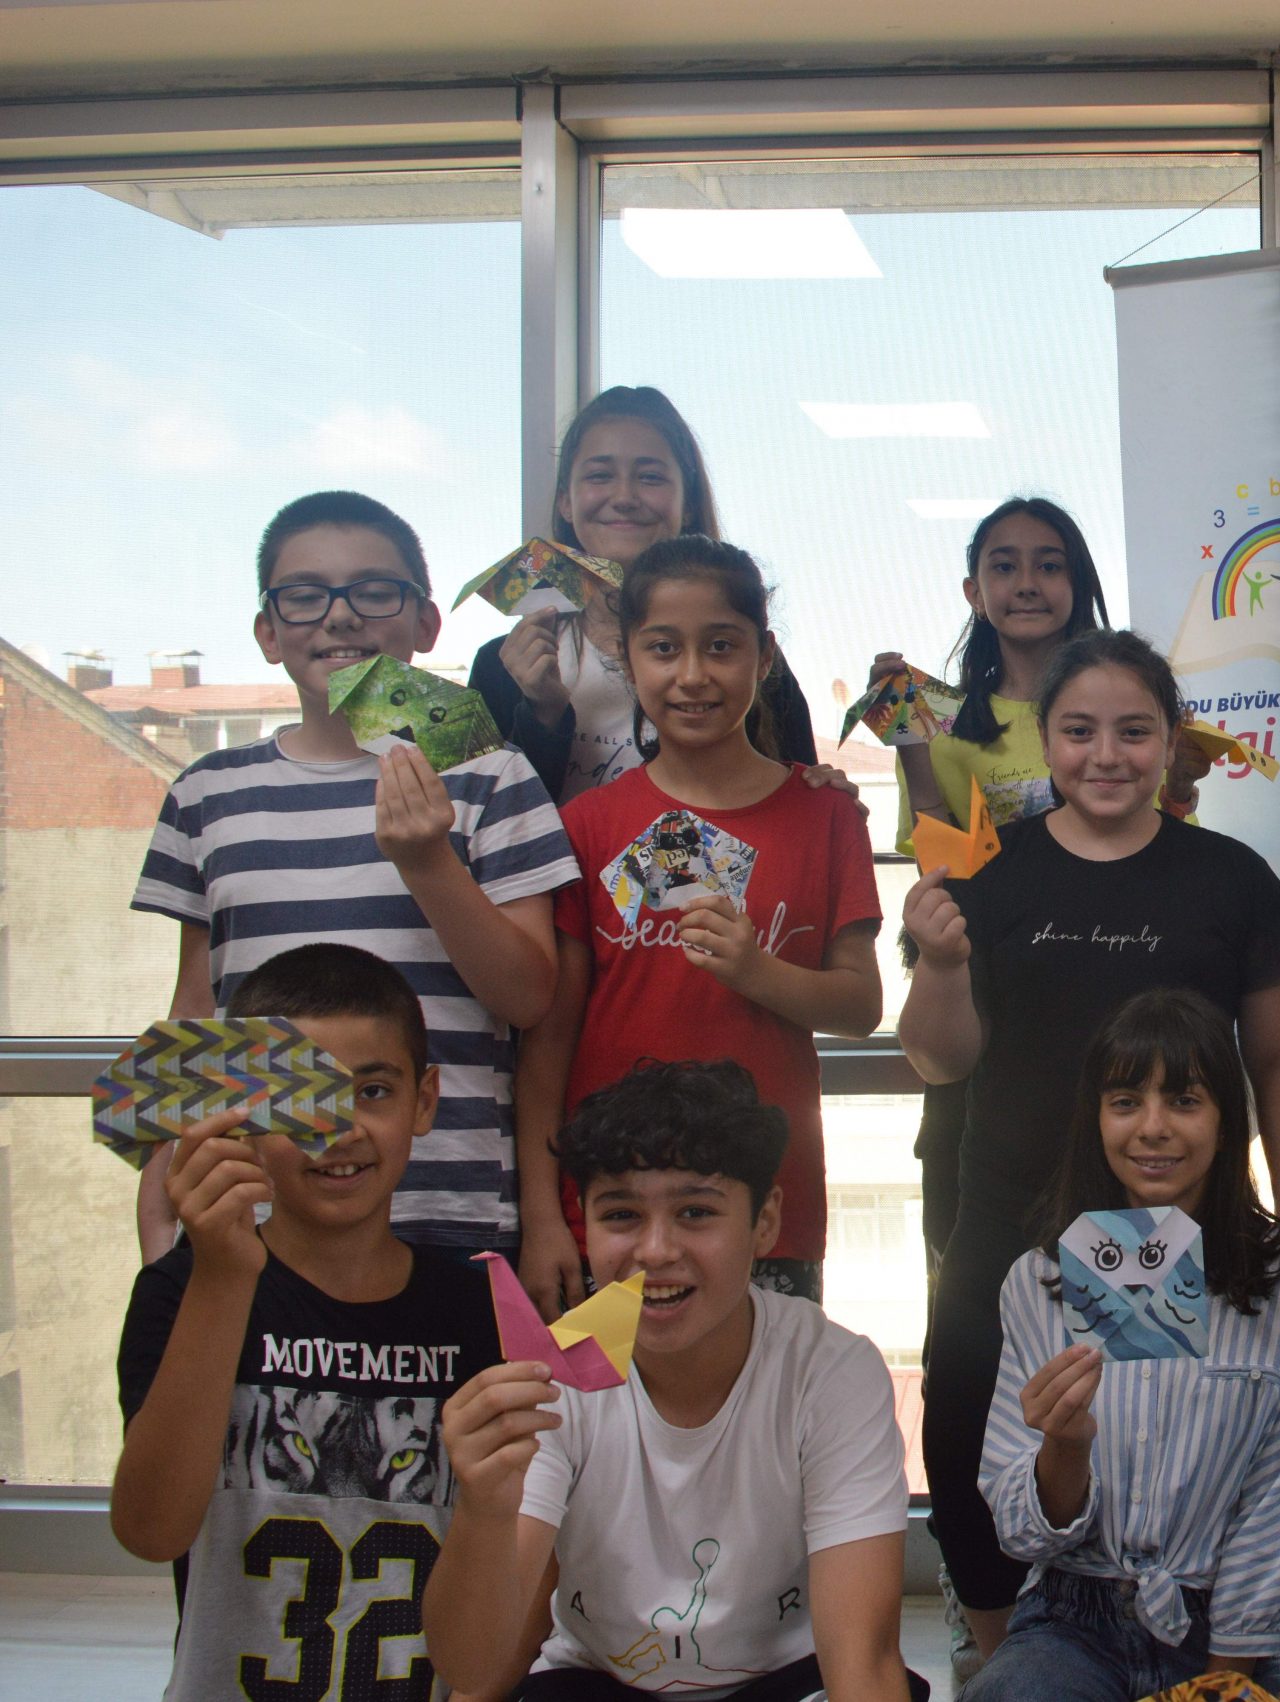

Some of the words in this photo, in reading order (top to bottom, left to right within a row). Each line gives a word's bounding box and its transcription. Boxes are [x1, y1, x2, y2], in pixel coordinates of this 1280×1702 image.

[1213, 509, 1226, 528] 3
[1182, 699, 1212, 714] DU
[1032, 922, 1083, 944] shine
[1091, 924, 1163, 952] happily
[260, 1333, 461, 1384] MOVEMENT
[240, 1515, 442, 1702] 32
[777, 1586, 801, 1621] R
